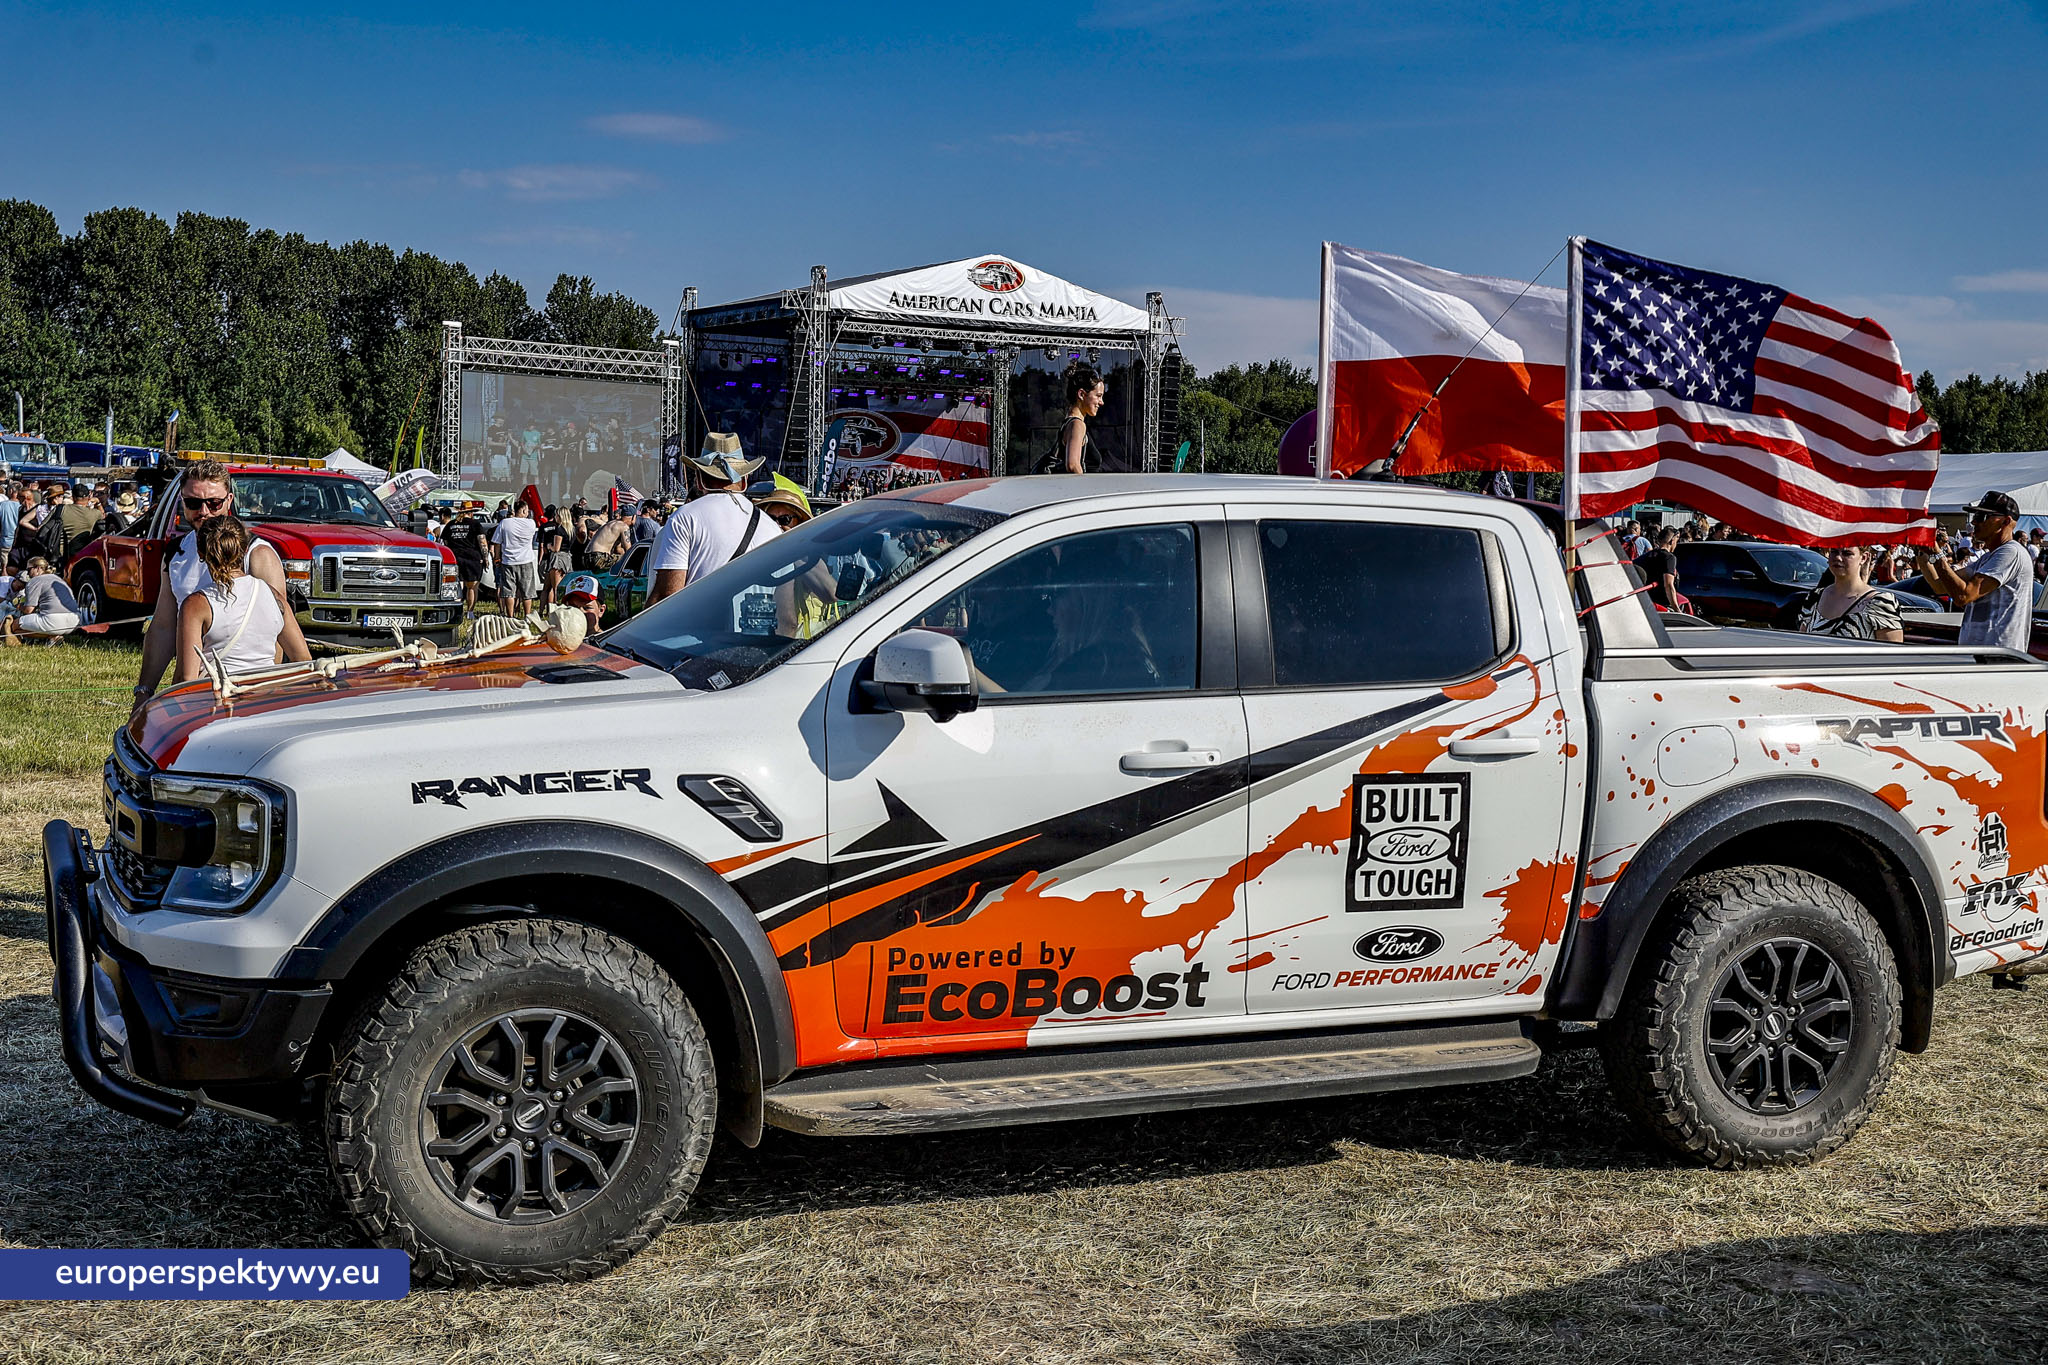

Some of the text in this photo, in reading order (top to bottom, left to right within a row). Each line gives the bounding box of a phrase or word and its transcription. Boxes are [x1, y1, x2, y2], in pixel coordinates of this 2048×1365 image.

[888, 290, 983, 315] AMERICAN
[989, 297, 1033, 318] CARS
[369, 616, 383, 626] SO
[1815, 715, 2016, 753] RAPTOR
[411, 768, 664, 810] RANGER
[1365, 787, 1459, 824] BUILT
[1380, 832, 1438, 857] Ford
[1360, 868, 1453, 898] TOUGH
[1961, 872, 2030, 916] FOX
[1371, 931, 1427, 956] Ford
[1950, 917, 2044, 951] BFGoodrich
[888, 940, 1076, 971] Powered by
[882, 961, 1210, 1024] EcoBoost
[1272, 962, 1501, 992] FORD PERFORMANCE
